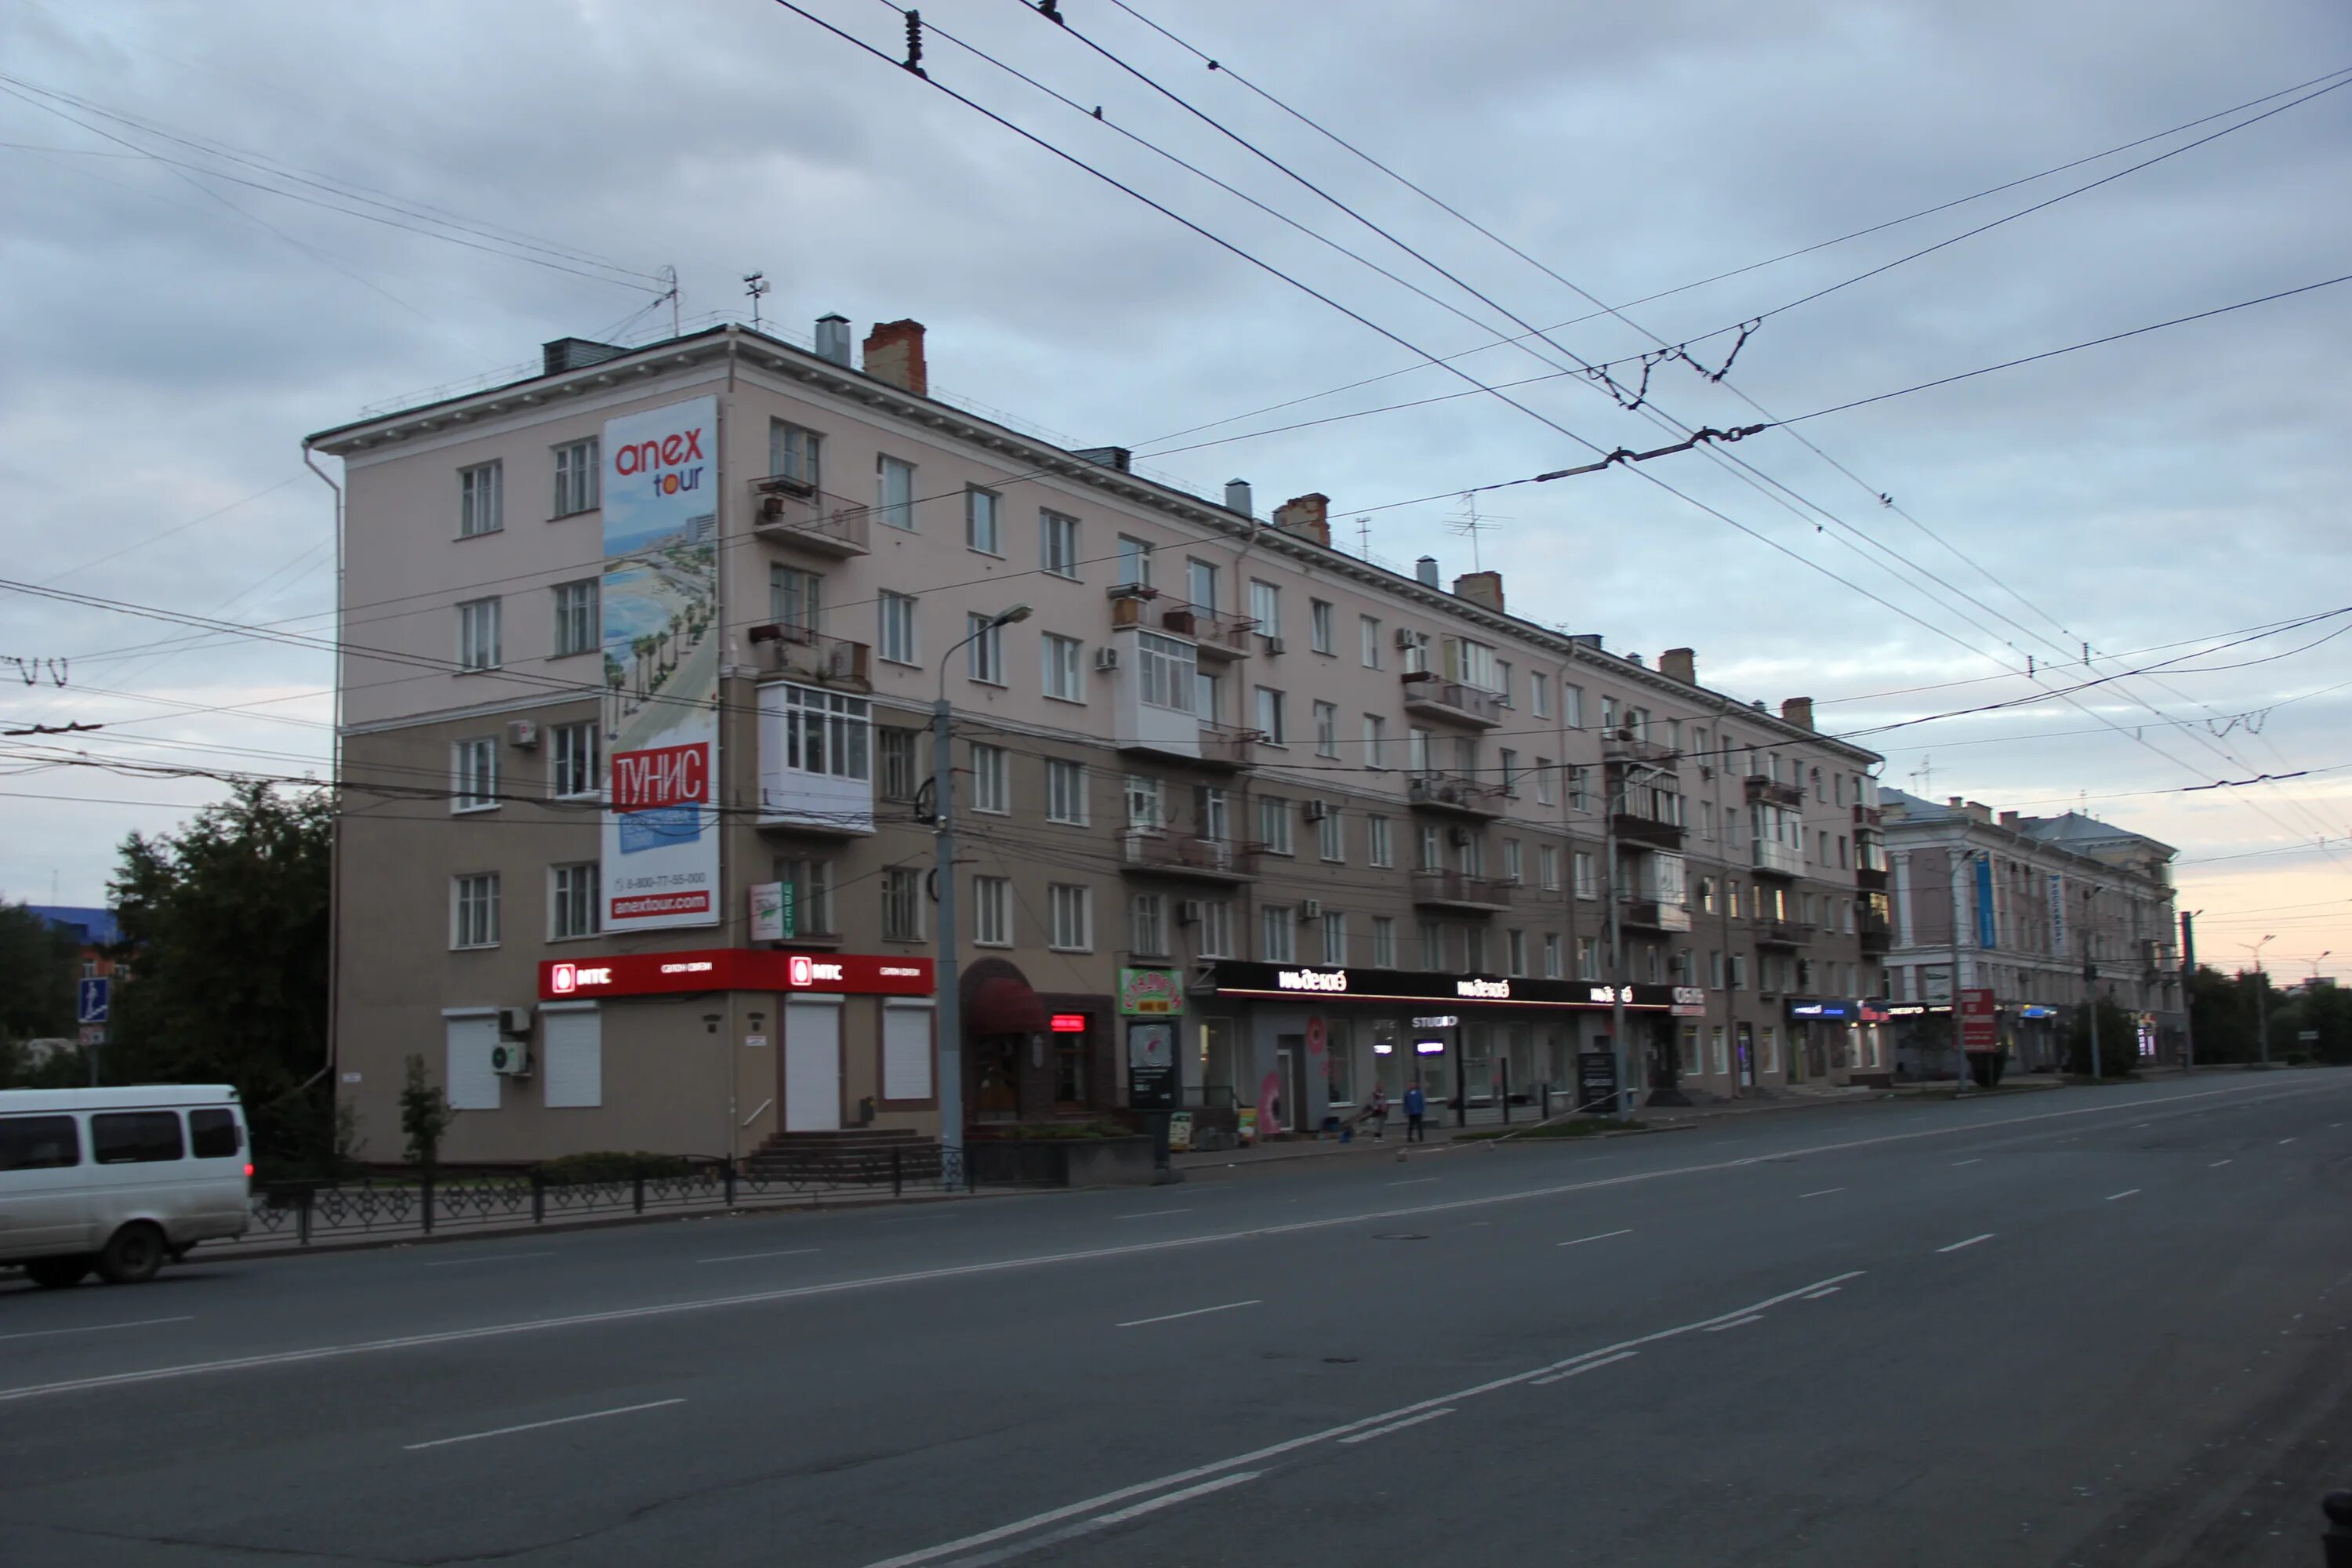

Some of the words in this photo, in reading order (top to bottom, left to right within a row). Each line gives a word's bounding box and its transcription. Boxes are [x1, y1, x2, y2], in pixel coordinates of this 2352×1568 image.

[615, 427, 704, 476] anex
[653, 466, 704, 497] tour
[616, 750, 701, 804] ТУНИС
[615, 896, 706, 913] anextour.com
[576, 967, 612, 985] МТС
[812, 964, 844, 980] МТС
[1411, 1016, 1459, 1028] STUDIO
